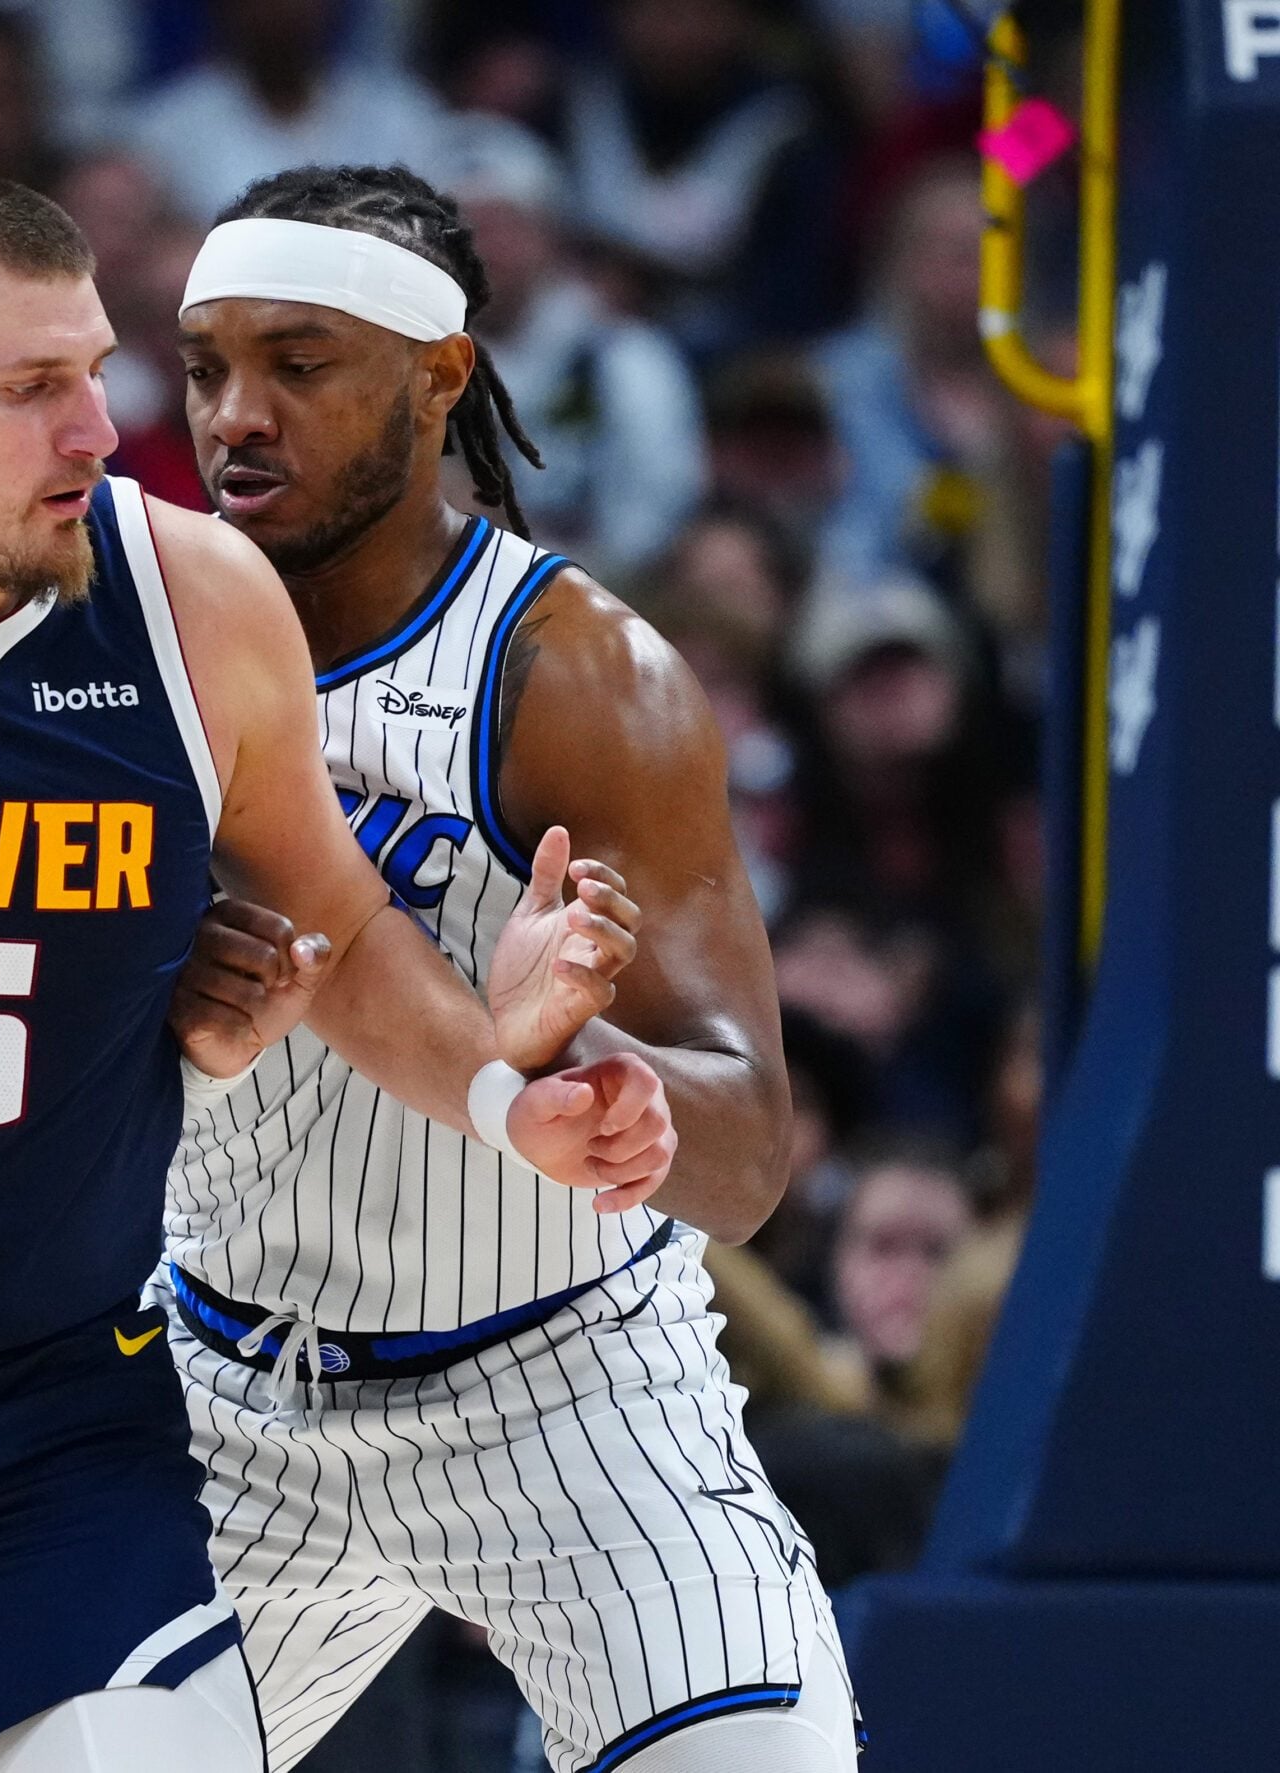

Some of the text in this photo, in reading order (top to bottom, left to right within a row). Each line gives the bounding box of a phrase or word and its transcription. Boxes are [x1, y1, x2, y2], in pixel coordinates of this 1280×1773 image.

[31, 681, 139, 712] ibotta
[376, 679, 466, 729] Disney
[336, 786, 475, 909] IC
